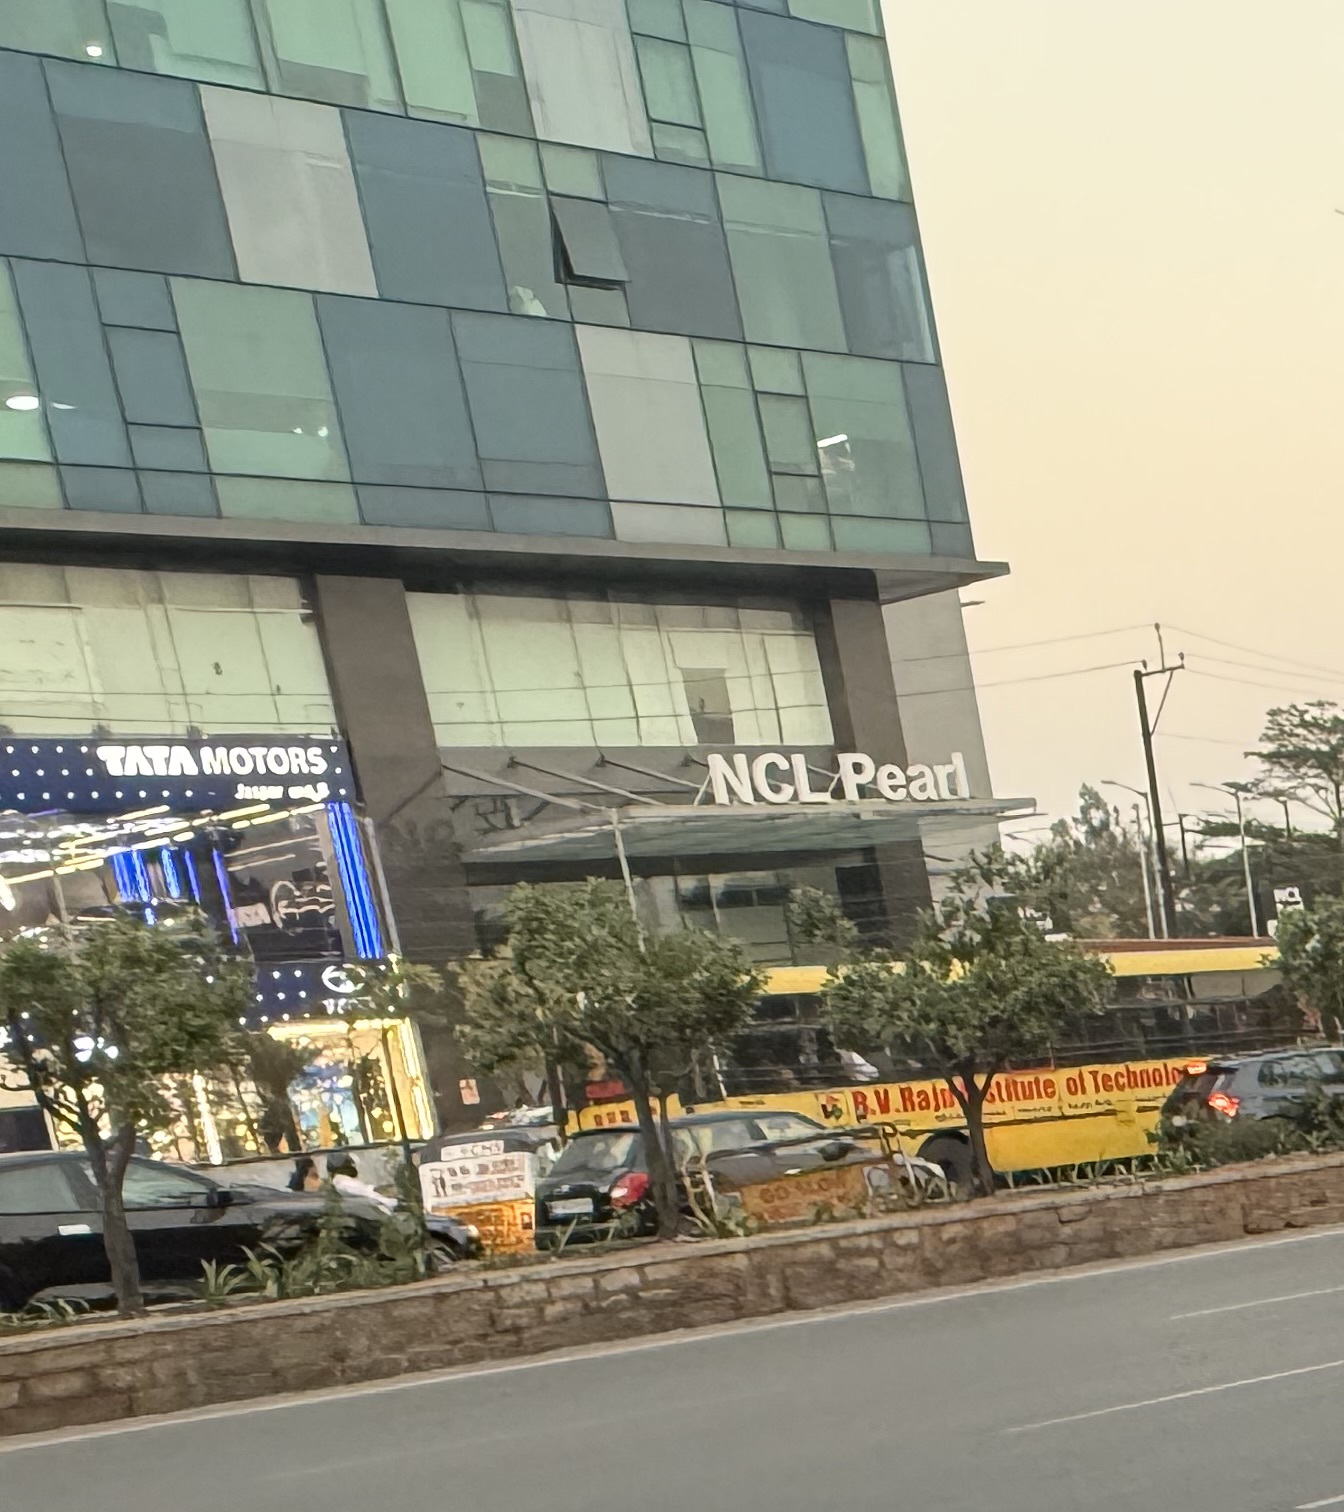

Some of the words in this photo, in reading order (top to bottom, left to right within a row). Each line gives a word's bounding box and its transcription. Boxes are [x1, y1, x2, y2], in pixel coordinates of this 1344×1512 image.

[97, 745, 198, 776] TATA
[200, 746, 328, 775] MOTORS
[707, 752, 832, 805] NCL
[837, 752, 970, 801] Pearl
